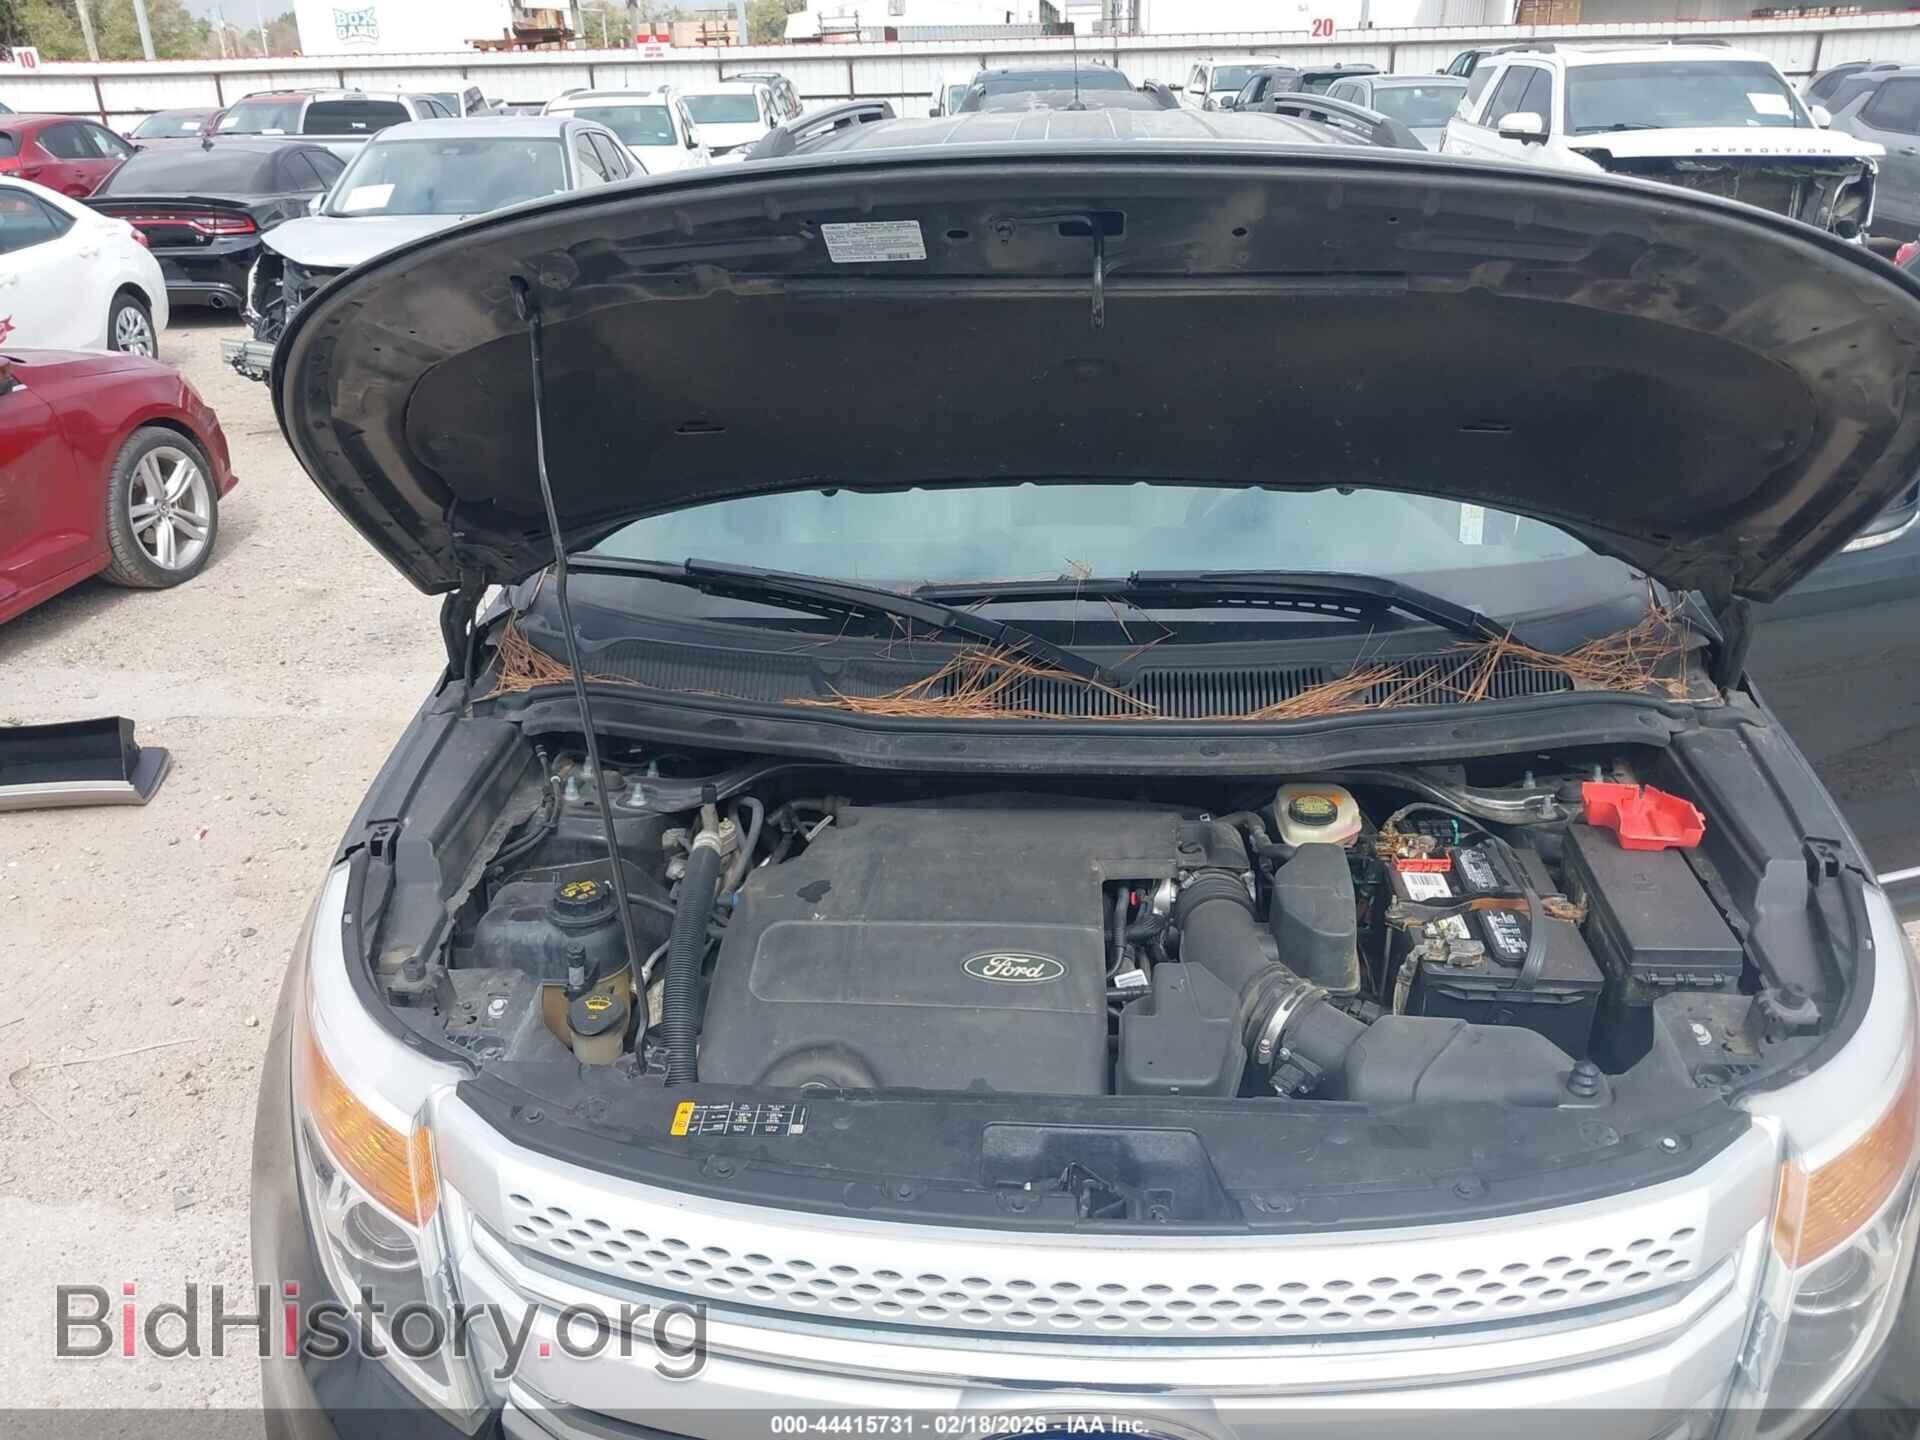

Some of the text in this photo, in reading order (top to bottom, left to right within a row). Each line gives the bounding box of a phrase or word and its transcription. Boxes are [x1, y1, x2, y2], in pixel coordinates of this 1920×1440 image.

[333, 6, 377, 26] BOX
[1312, 18, 1334, 37] 20
[16, 51, 36, 69] 10
[983, 956, 1045, 978] Ford
